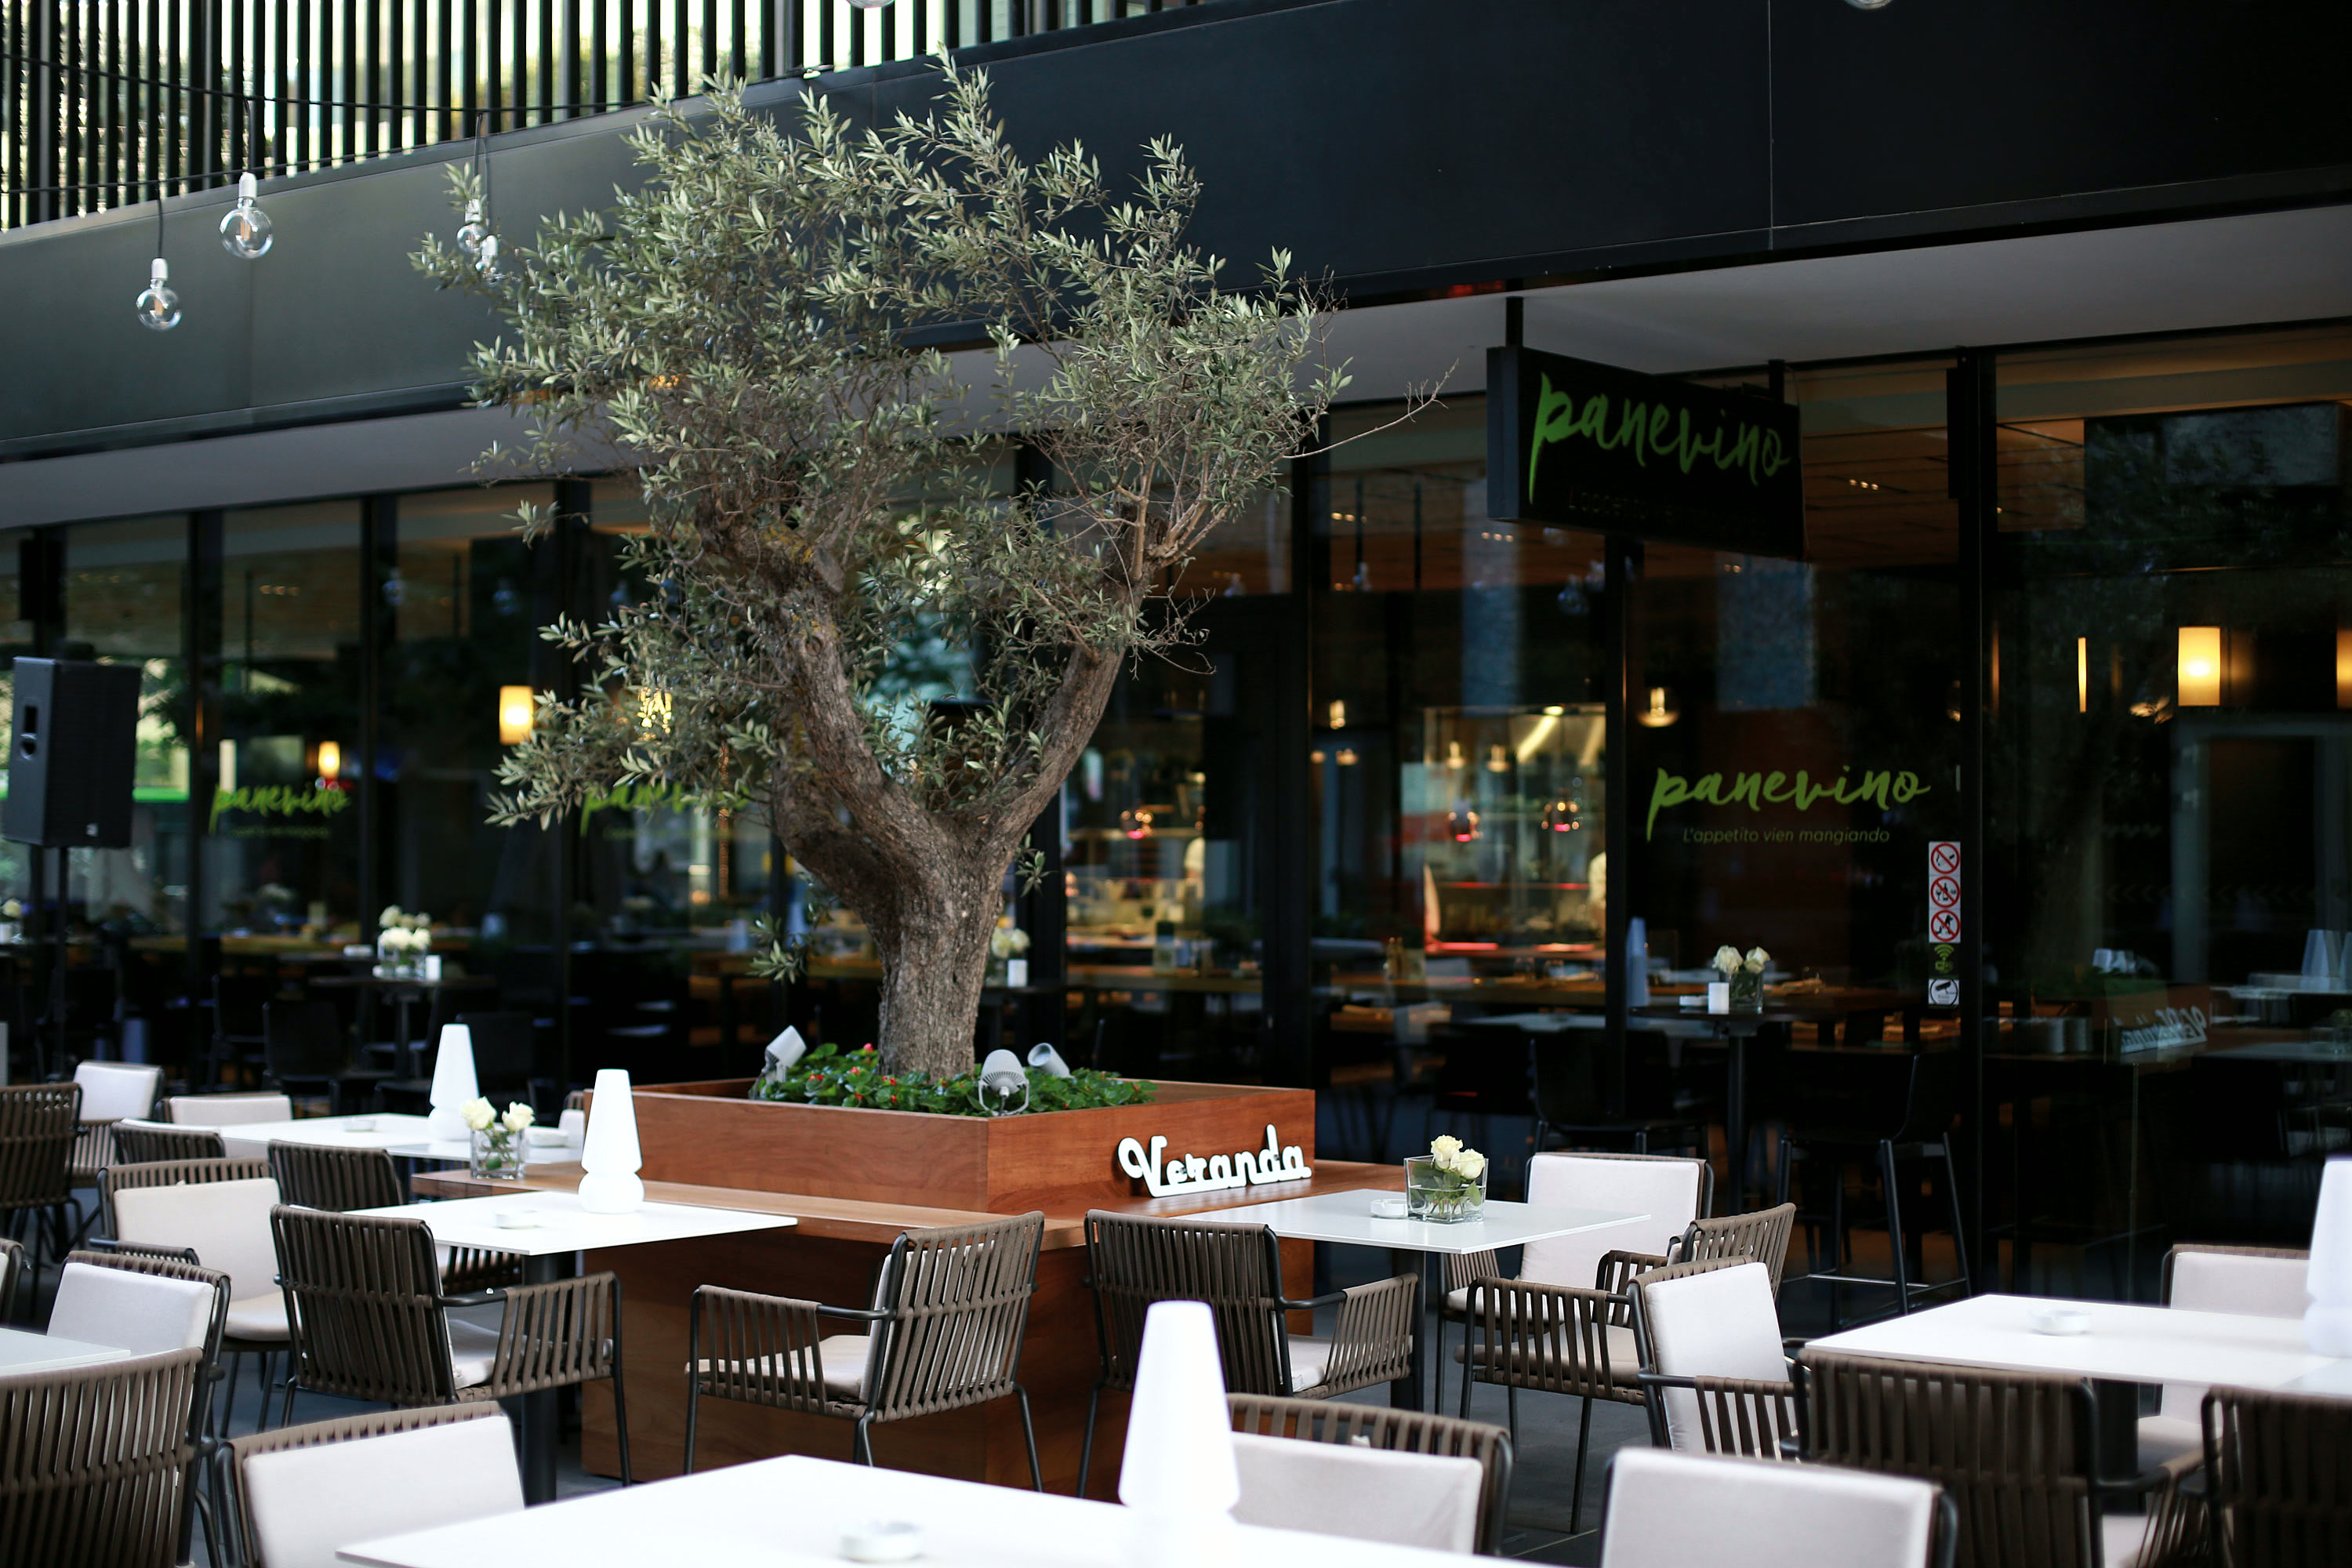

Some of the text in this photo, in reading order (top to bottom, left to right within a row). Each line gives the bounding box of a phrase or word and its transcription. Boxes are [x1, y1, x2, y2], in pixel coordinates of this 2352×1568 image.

[1529, 372, 1790, 504] panevino
[1646, 765, 1931, 842] panevino
[1683, 826, 1890, 845] L'appetito vien mangiando
[1117, 1123, 1312, 1198] Veranda
